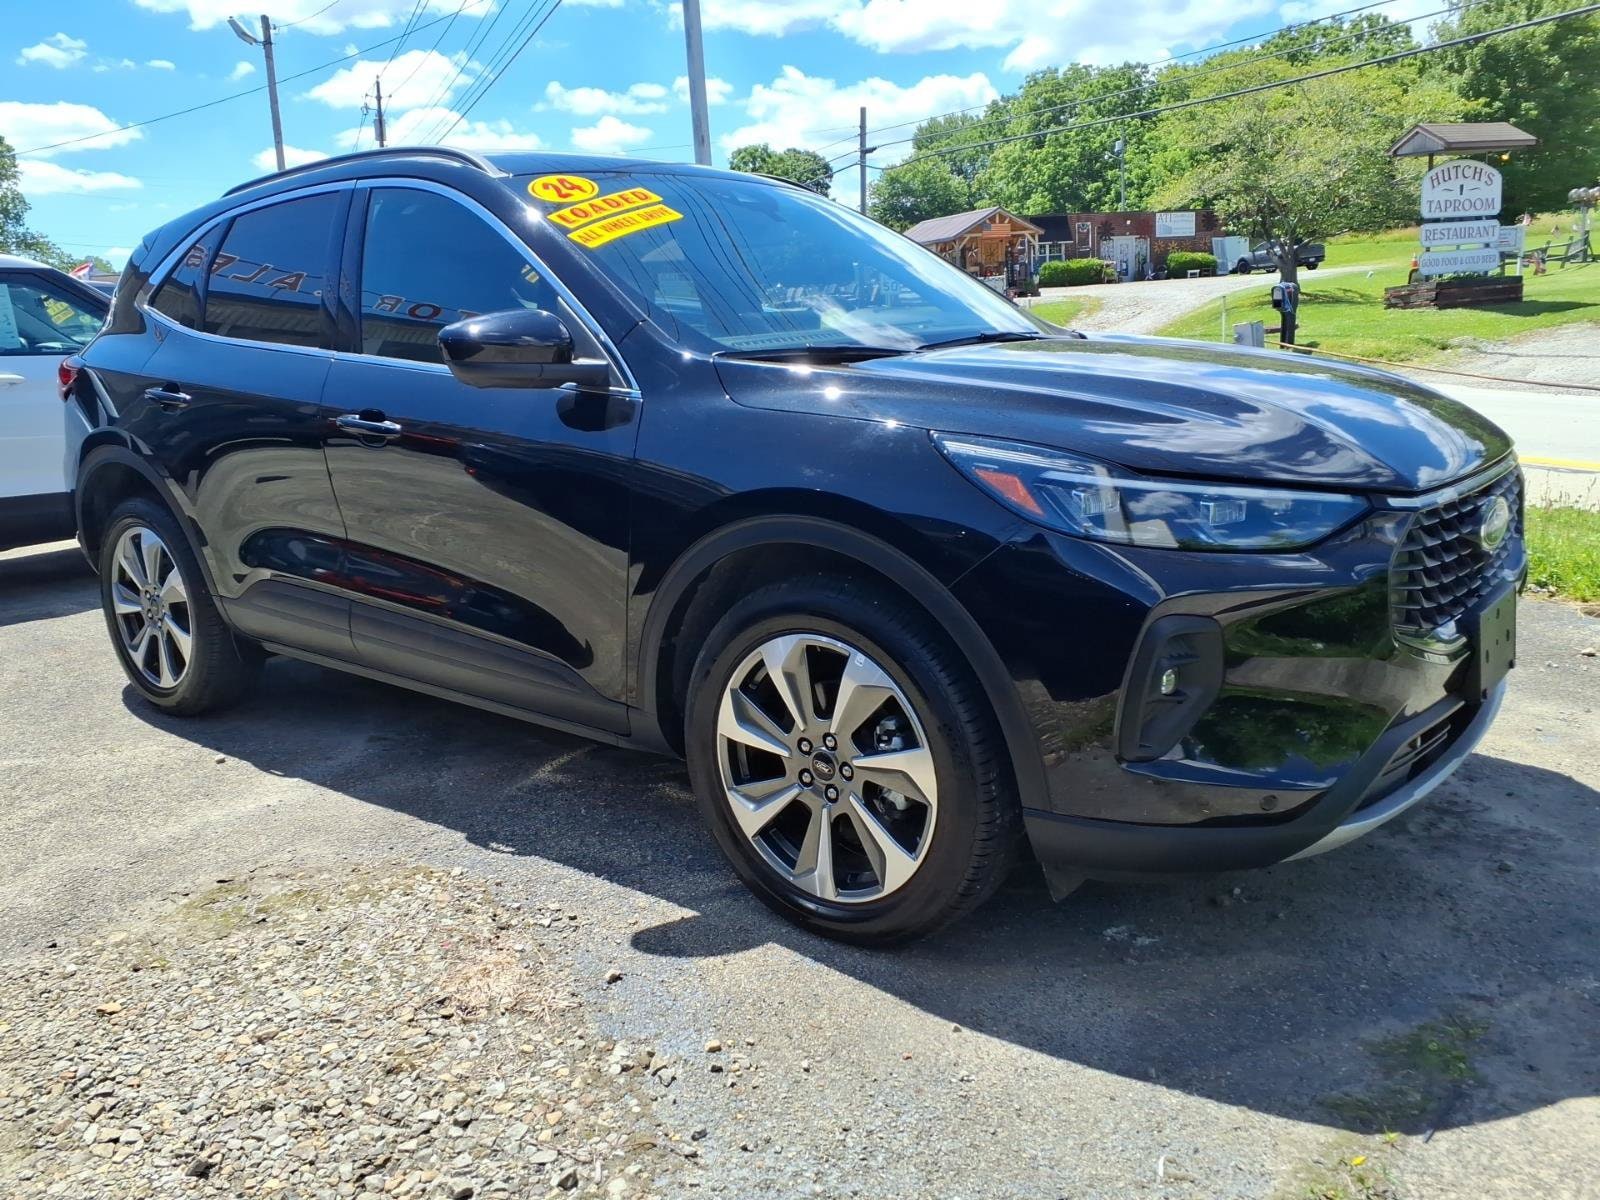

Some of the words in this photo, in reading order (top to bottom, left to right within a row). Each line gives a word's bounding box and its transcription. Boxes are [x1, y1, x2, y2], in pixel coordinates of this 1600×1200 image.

[1430, 164, 1495, 189] HUTCH'S
[542, 177, 588, 199] 24
[556, 191, 651, 224] LOADED
[1426, 197, 1496, 213] TAPROOM
[1424, 224, 1498, 241] RESTAURANT
